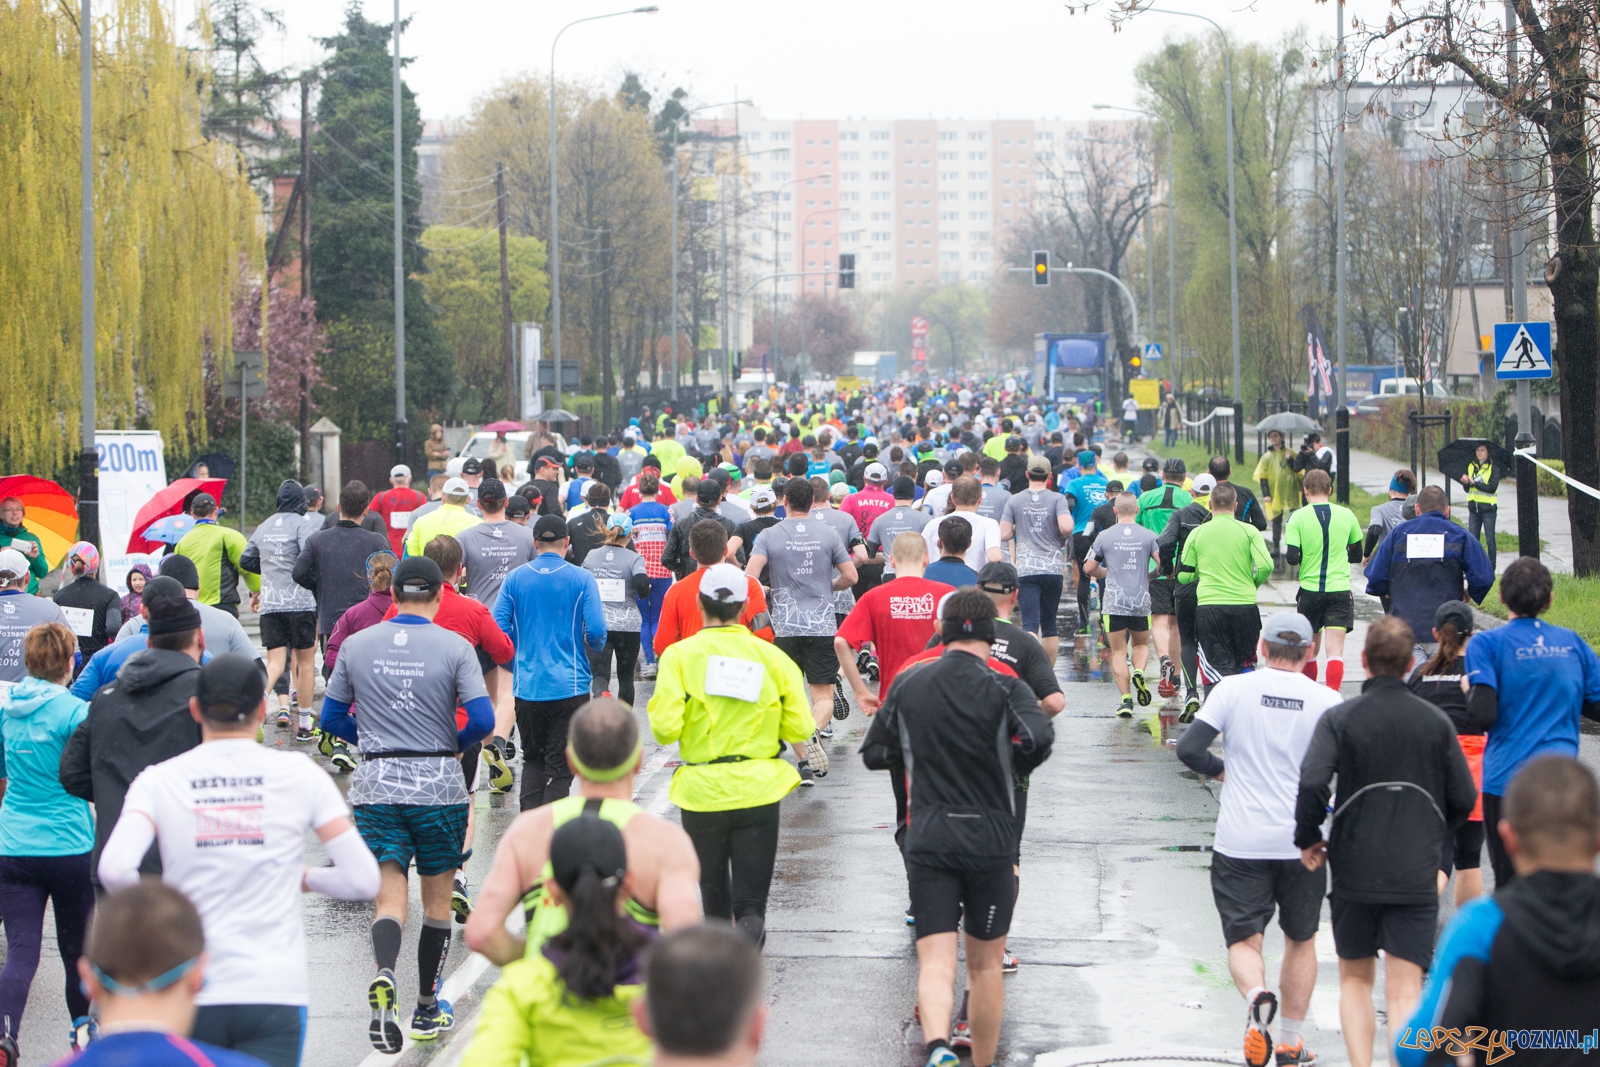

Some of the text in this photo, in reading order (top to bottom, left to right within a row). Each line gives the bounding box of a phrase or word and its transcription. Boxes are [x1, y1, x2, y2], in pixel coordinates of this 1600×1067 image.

[858, 499, 890, 509] BARTEK
[805, 551, 814, 559] 17
[501, 557, 509, 565] 17
[801, 559, 814, 567] .04
[794, 567, 814, 575] .2016
[890, 602, 934, 613] SZPIKU
[12, 639, 22, 647] 17
[5, 648, 21, 657] .04
[382, 666, 424, 677] Poznaniu
[402, 678, 413, 688] 17
